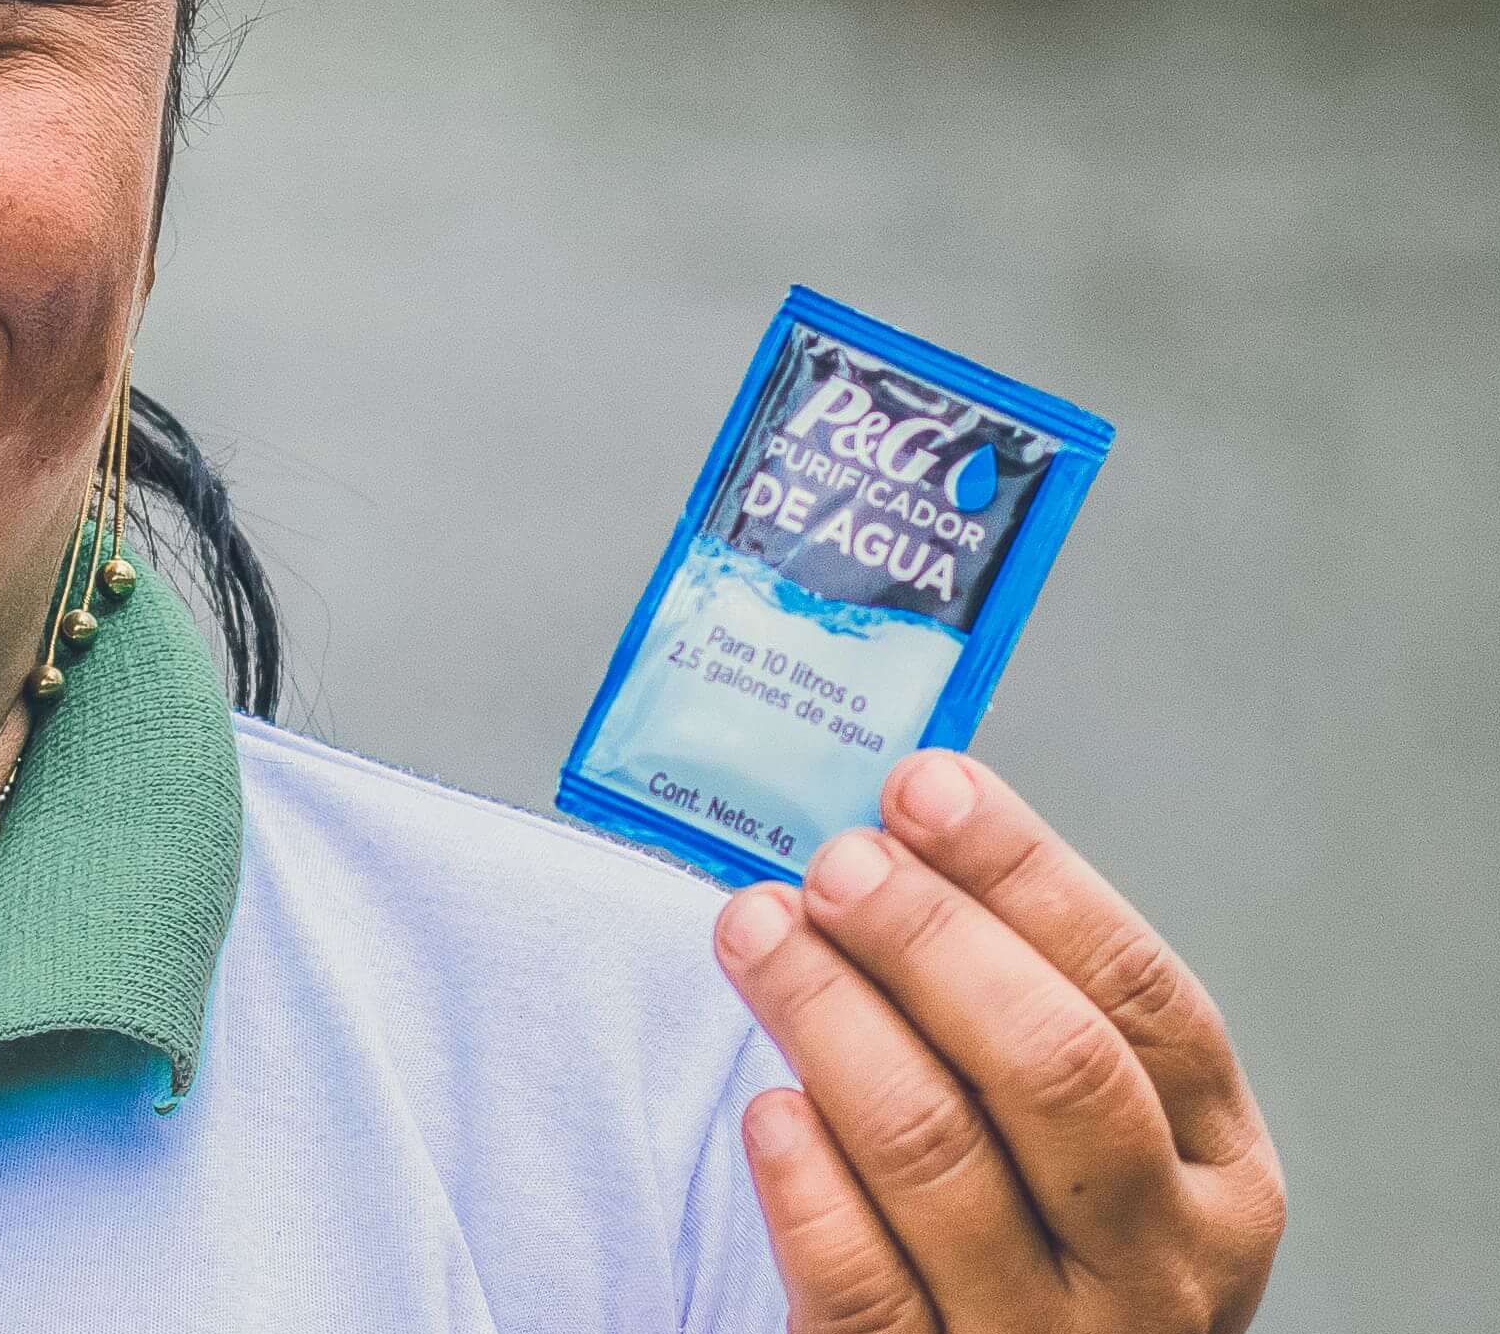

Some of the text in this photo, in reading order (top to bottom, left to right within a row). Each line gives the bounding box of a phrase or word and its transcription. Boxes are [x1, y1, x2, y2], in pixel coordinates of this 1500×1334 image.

[784, 375, 955, 483] P&G
[742, 472, 954, 602] DE AGUA
[765, 435, 985, 552] PURIFICADOR
[704, 660, 792, 710] galones
[795, 698, 825, 724] de
[828, 715, 884, 753] agua
[707, 625, 866, 713] Para 10 litros o
[649, 772, 794, 856] Cont. Neto: 4g
